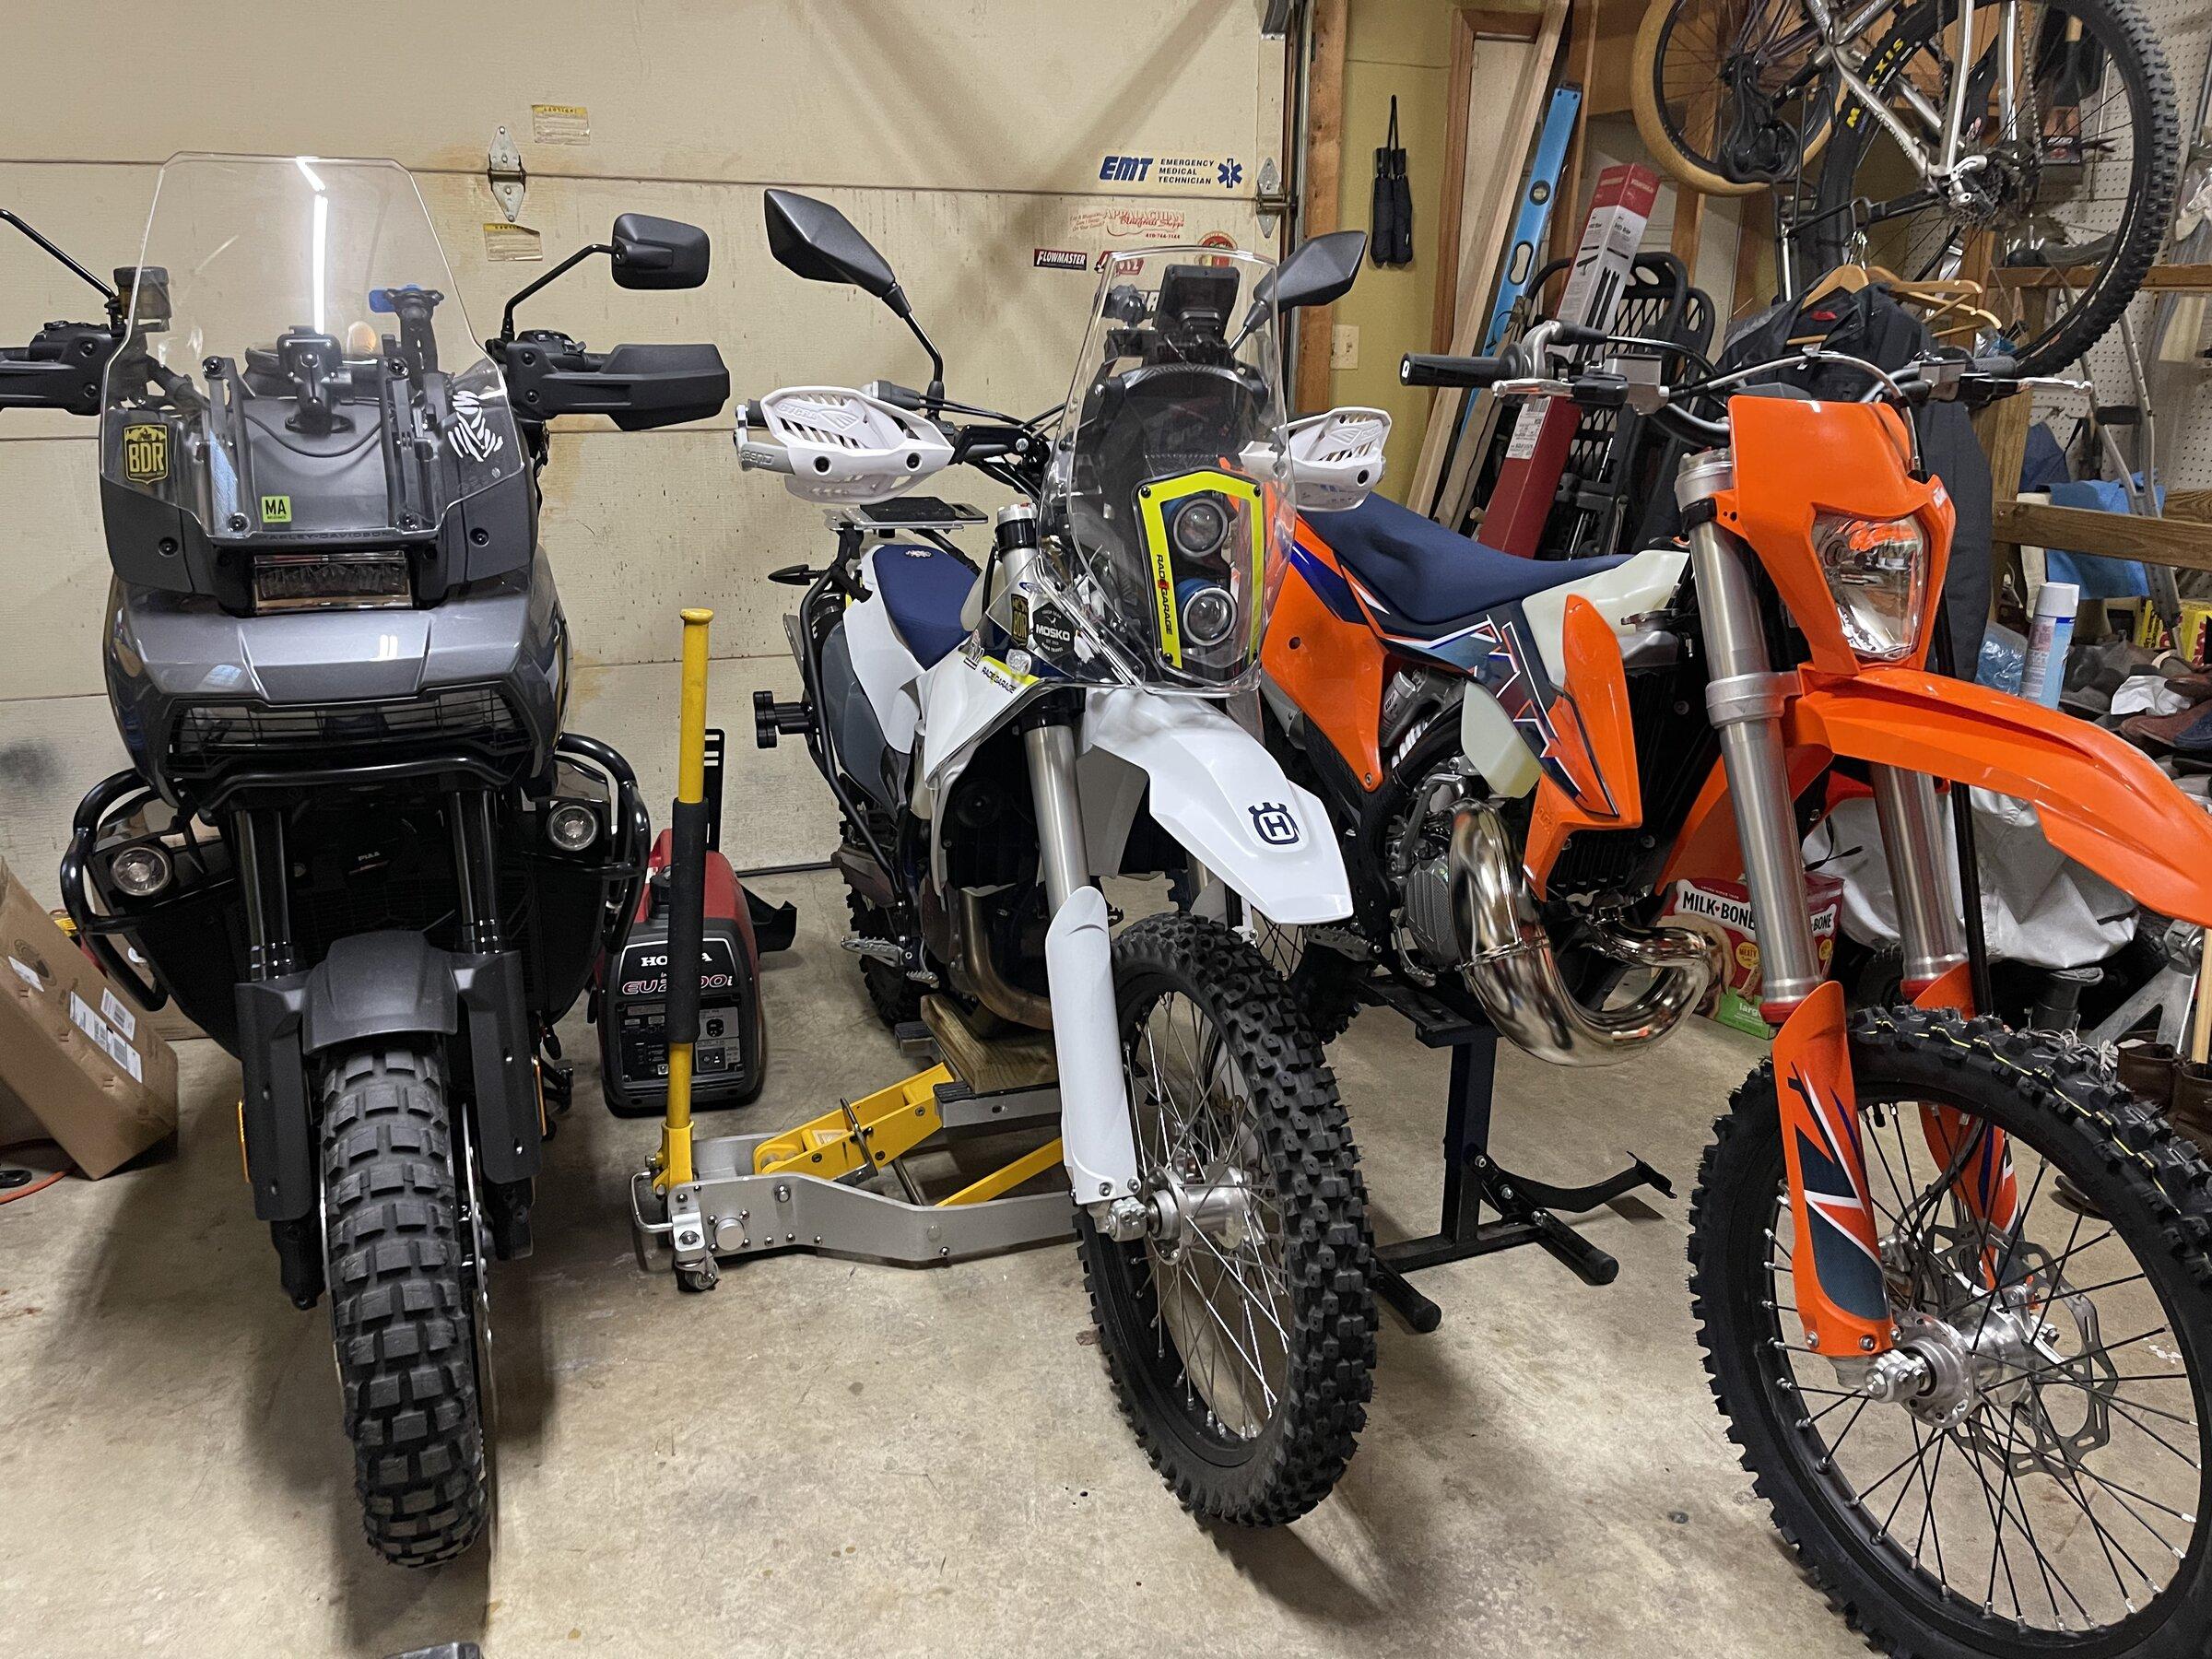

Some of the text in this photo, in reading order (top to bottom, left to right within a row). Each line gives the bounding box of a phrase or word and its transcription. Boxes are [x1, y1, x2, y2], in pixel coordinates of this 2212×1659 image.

[1100, 156, 1154, 182] EMT
[1160, 159, 1215, 167] EMERGENCY
[1159, 176, 1211, 184] TECHNICIAN
[1037, 251, 1086, 265] FLOWMASTER
[129, 442, 165, 472] BDR
[265, 500, 287, 515] MA
[1036, 623, 1071, 641] MOSKO
[1813, 912, 1832, 931] BONE
[641, 952, 712, 967] HOA
